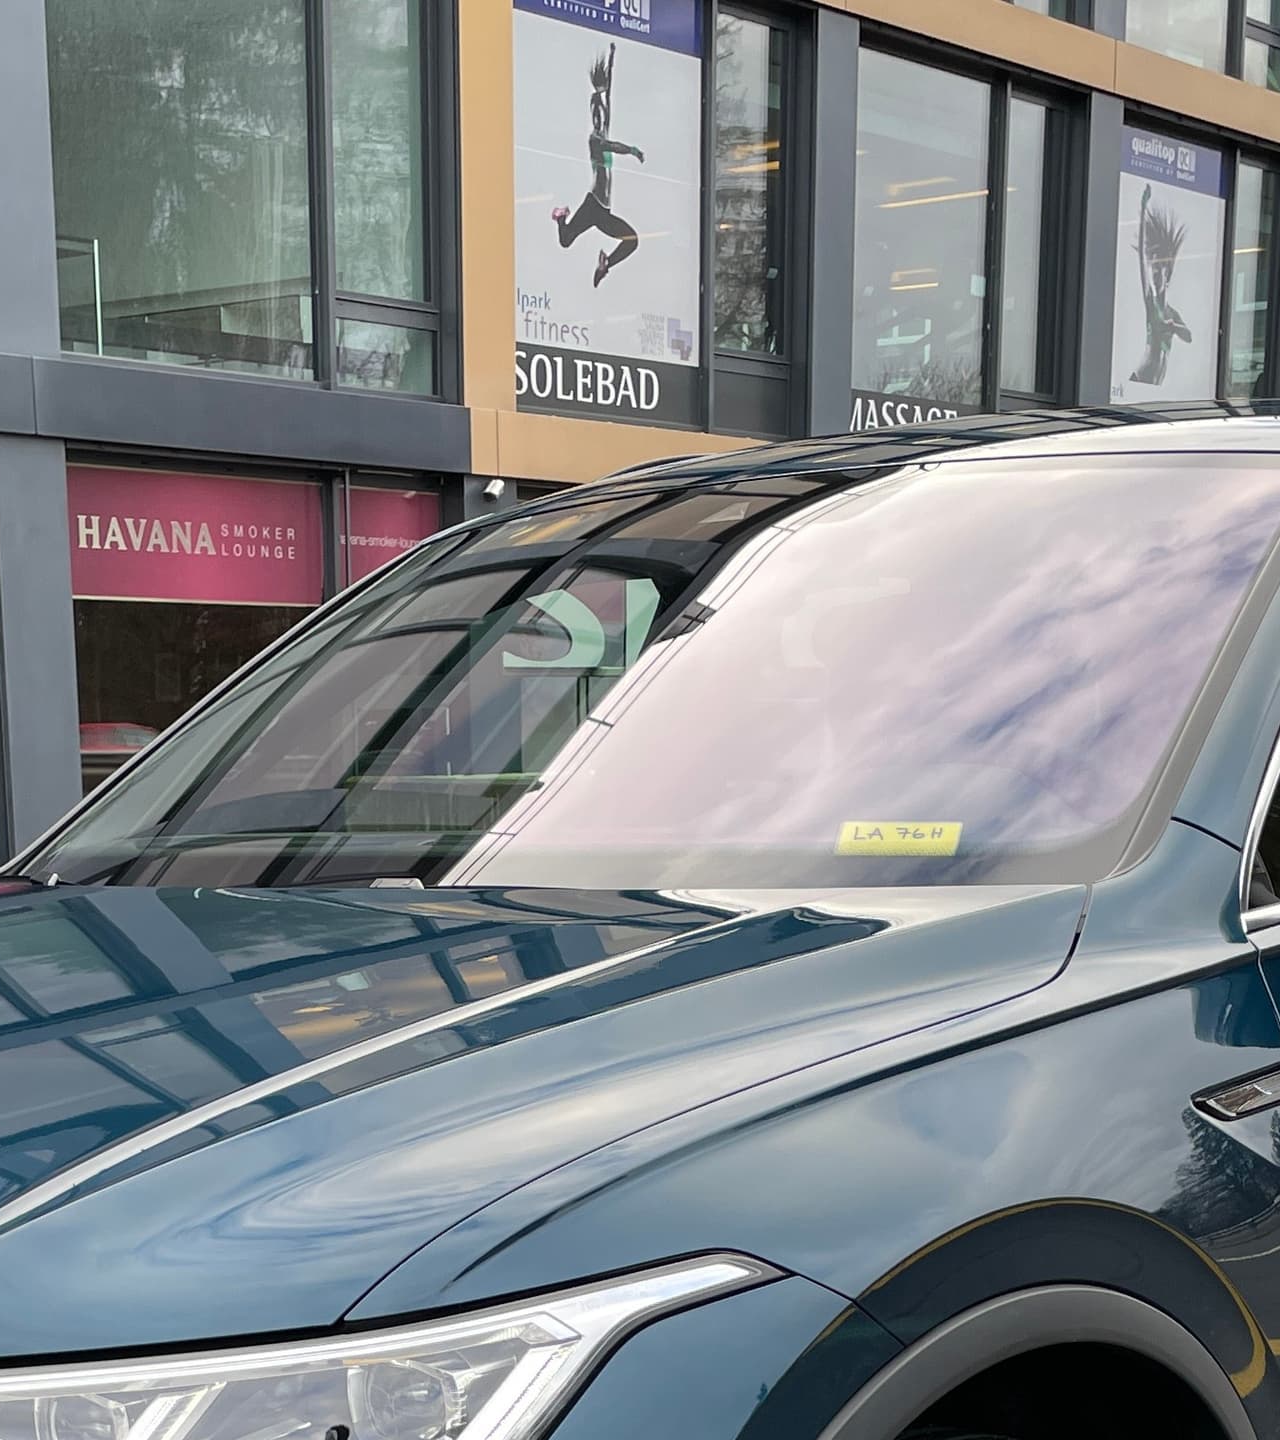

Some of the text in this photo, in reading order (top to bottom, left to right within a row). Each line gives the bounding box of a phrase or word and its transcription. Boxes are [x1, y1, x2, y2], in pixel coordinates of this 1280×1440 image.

[1131, 136, 1176, 165] qualitop
[523, 310, 590, 346] fitness
[515, 351, 659, 410] SOLEBAD
[77, 514, 216, 555] HAVANA
[220, 523, 296, 541] SMOKER
[221, 543, 296, 559] LOUNGE
[853, 826, 884, 840] LA
